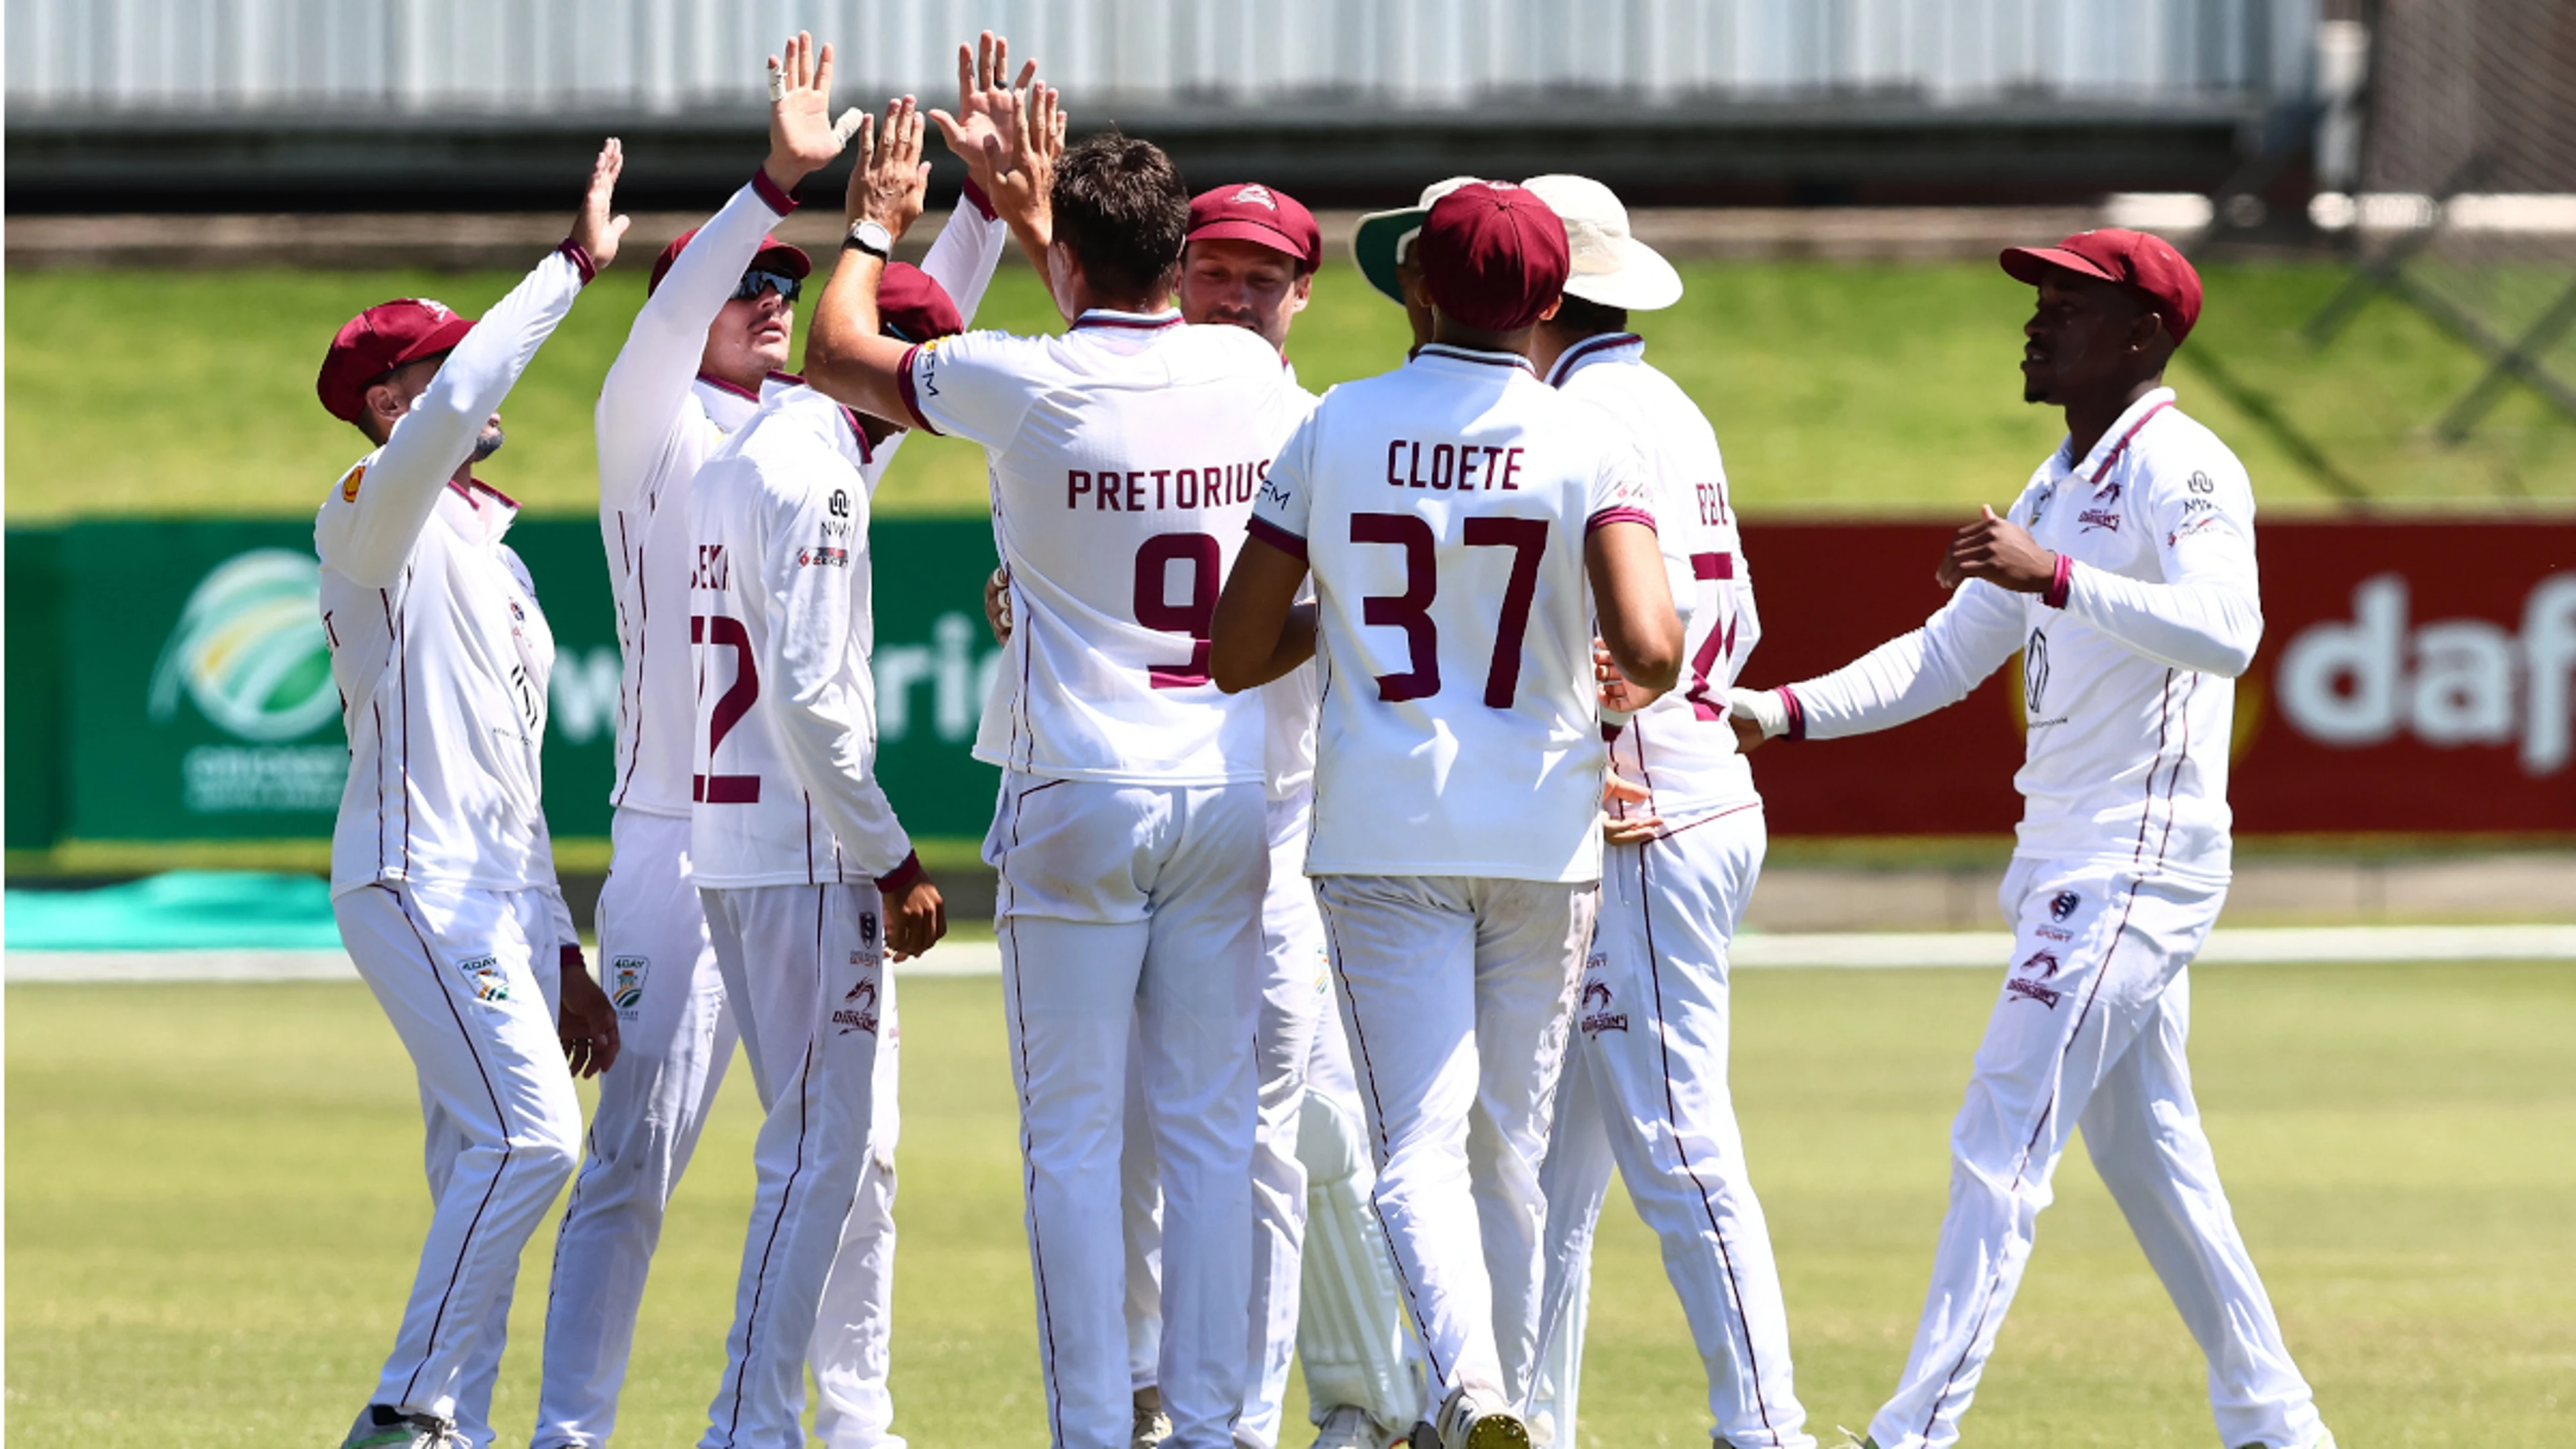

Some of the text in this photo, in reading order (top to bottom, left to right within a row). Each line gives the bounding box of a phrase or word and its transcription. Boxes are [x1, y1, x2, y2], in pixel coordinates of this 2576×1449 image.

[1067, 459, 1270, 511] PRETORIUS
[1387, 440, 1524, 490] CLOETE
[1134, 533, 1220, 689] 9
[1350, 513, 1550, 708] 37
[2275, 570, 2576, 775] daf
